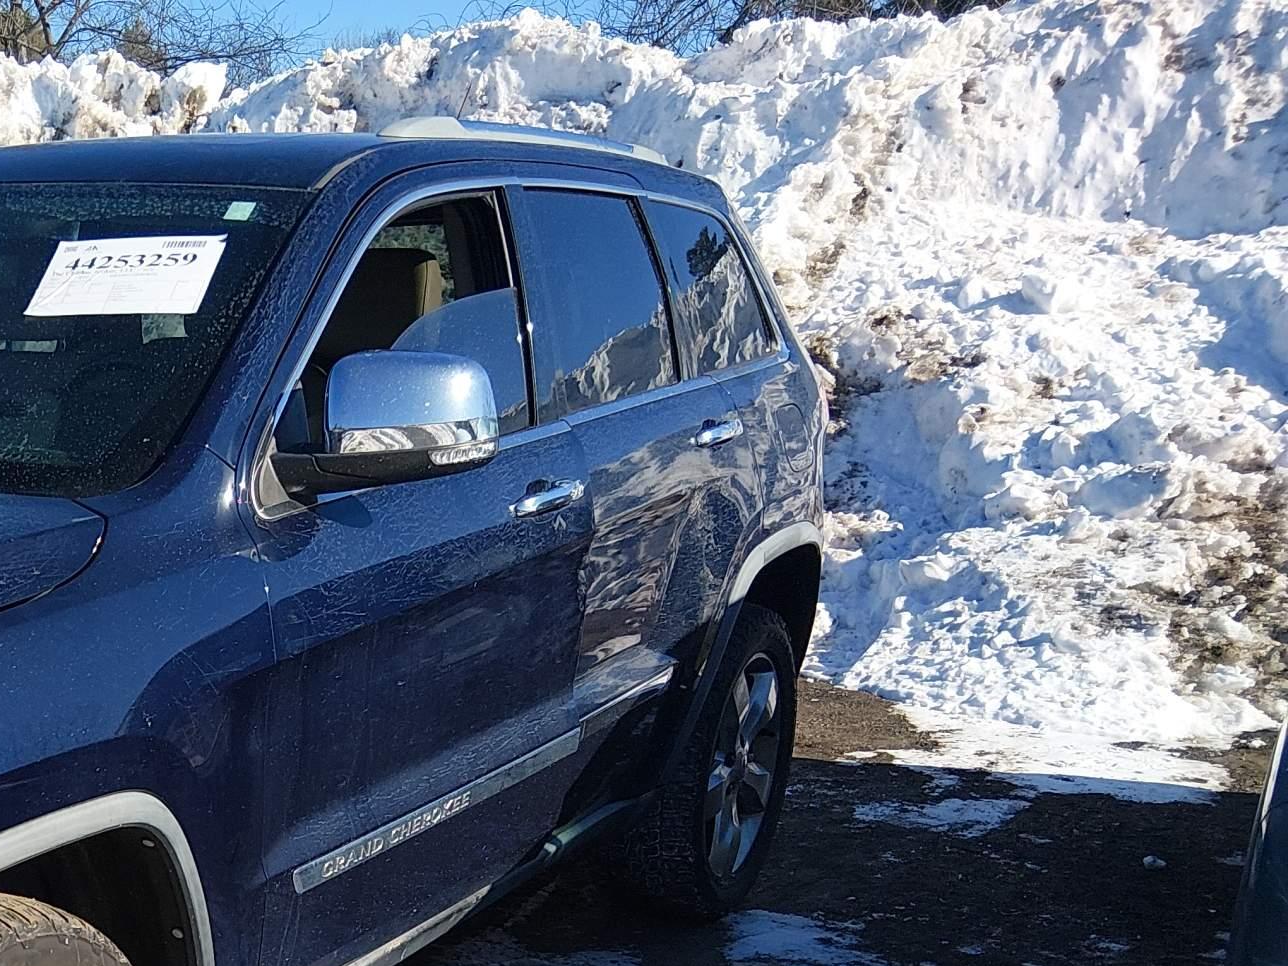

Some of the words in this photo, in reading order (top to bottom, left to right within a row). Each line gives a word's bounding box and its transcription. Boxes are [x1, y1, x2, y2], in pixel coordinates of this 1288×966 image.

[65, 253, 198, 271] 44253259
[320, 838, 385, 879] GRAND
[389, 790, 472, 845] CHEROKEE
